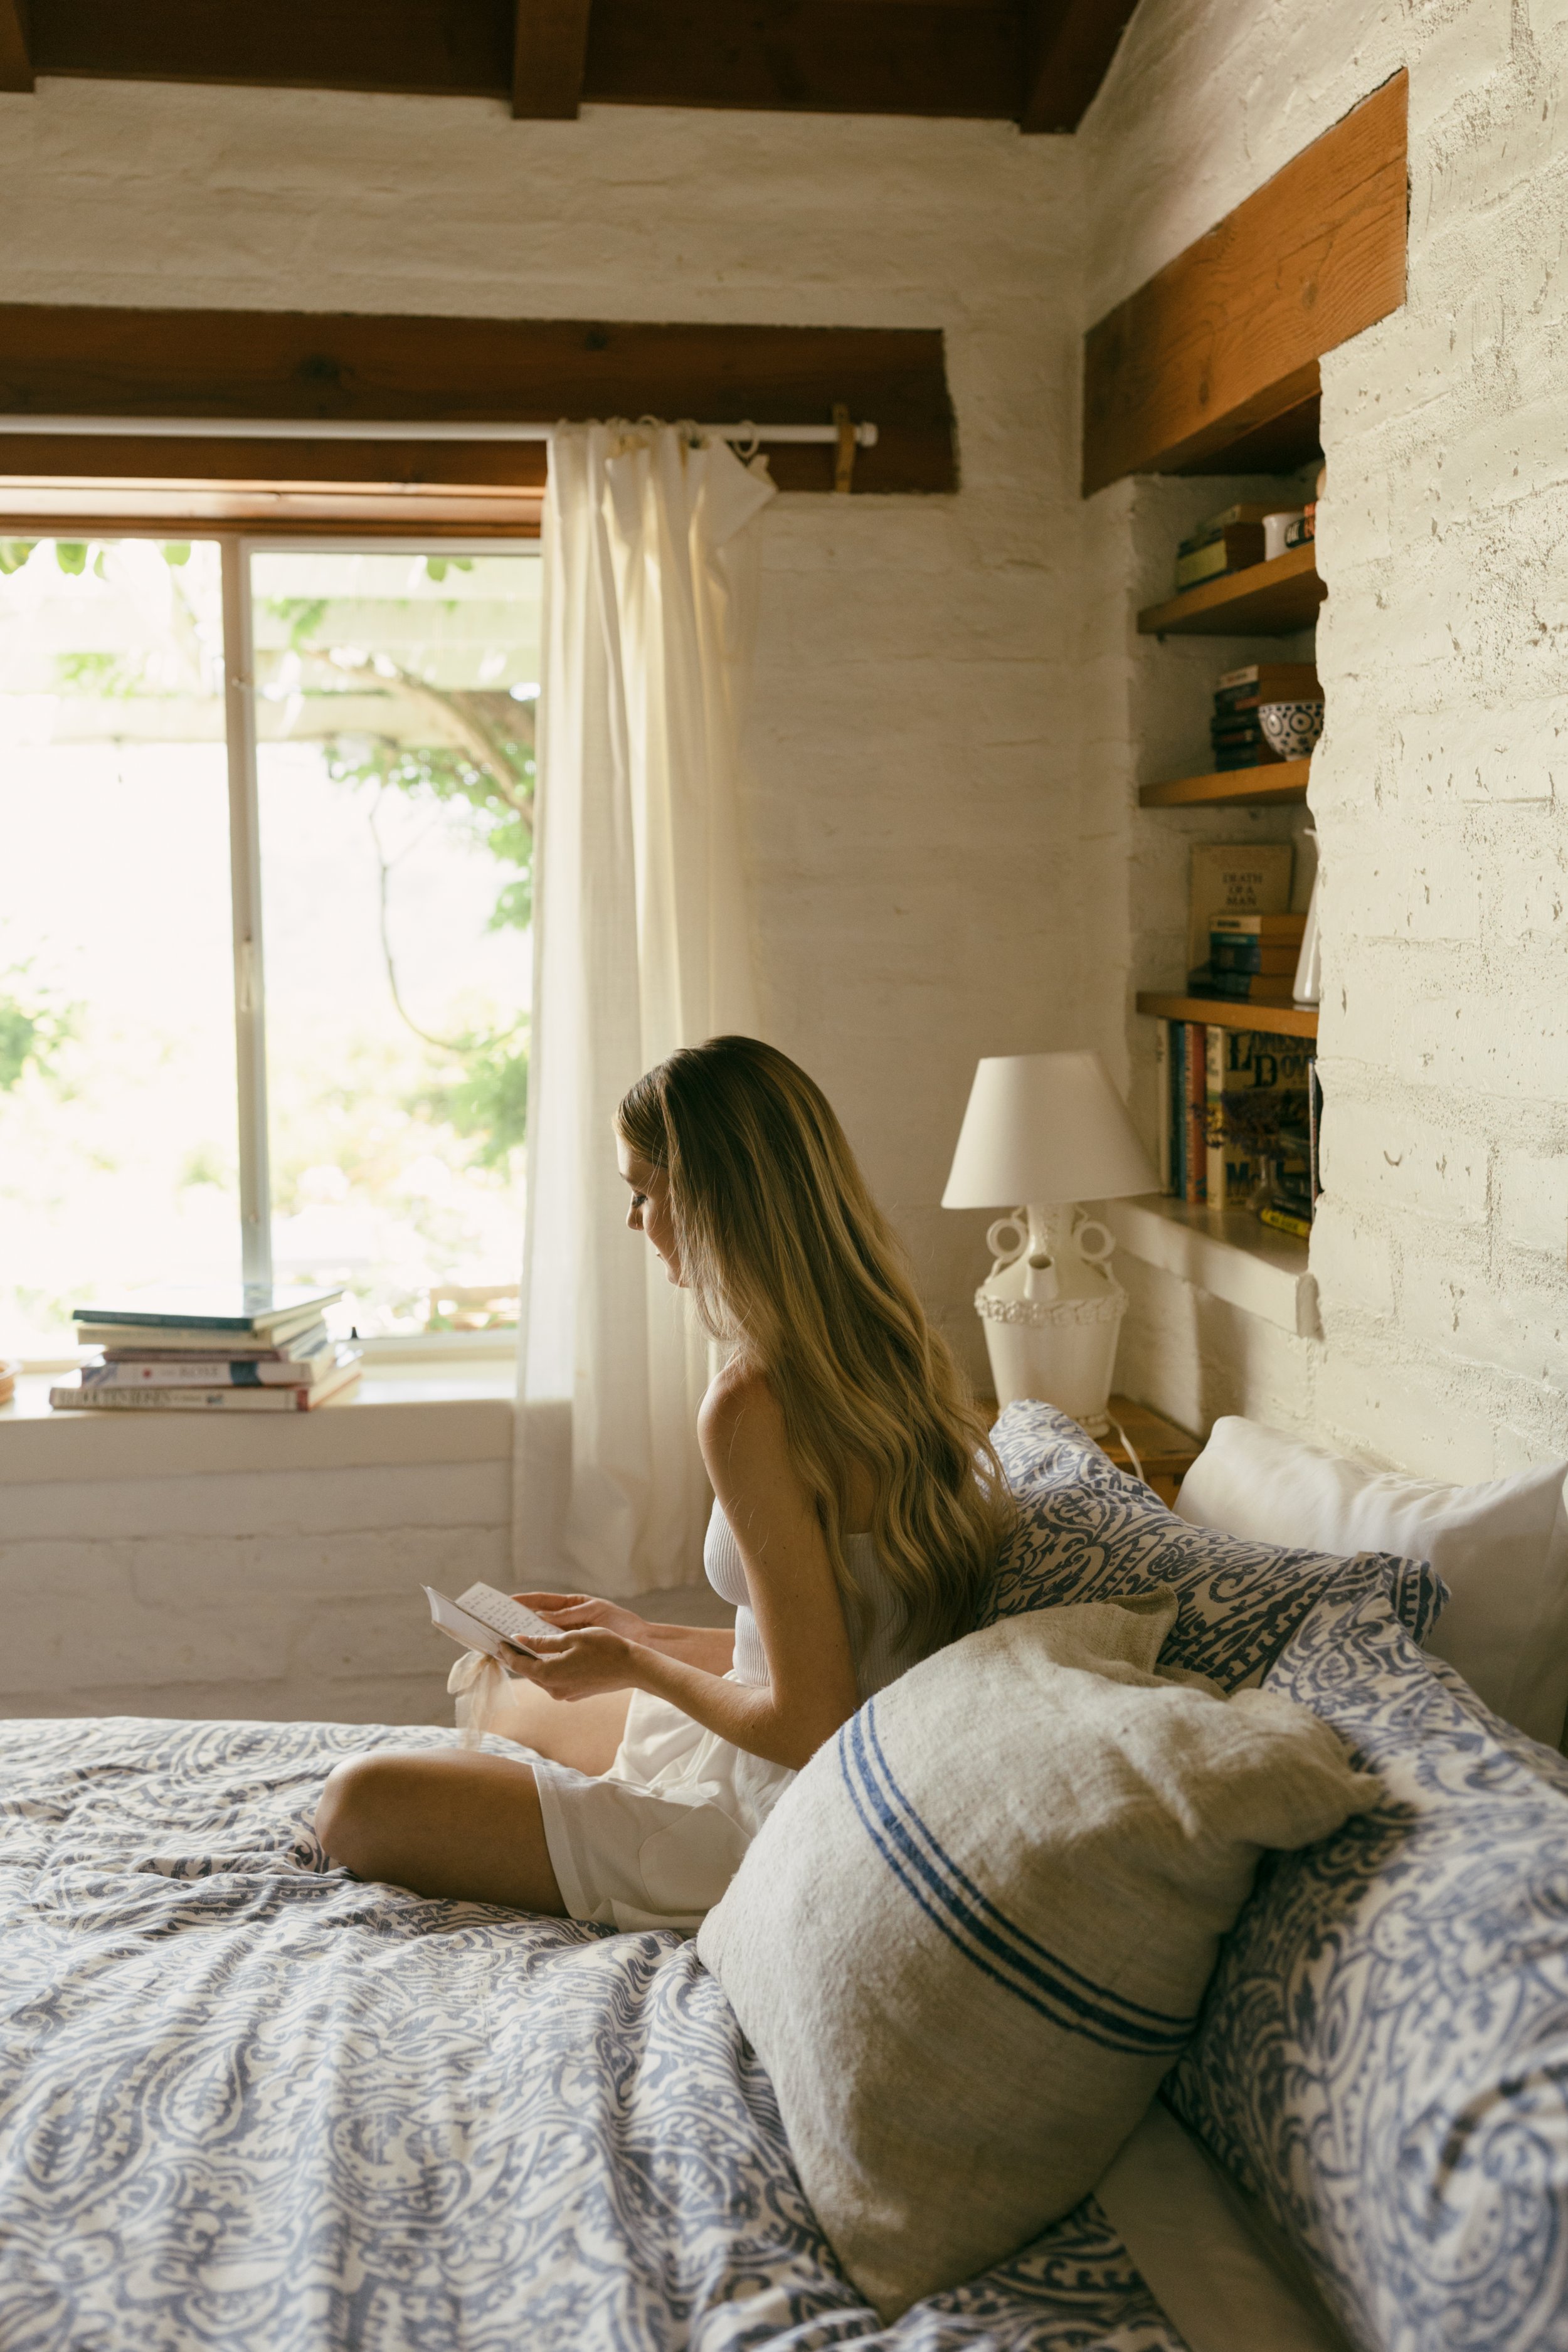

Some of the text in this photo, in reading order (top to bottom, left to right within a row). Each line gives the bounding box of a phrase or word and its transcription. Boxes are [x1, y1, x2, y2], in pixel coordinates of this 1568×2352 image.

[1223, 872, 1263, 884] DEATH
[1229, 886, 1254, 894] OF A
[1226, 896, 1257, 906] MAN
[1242, 1054, 1312, 1089] DOV
